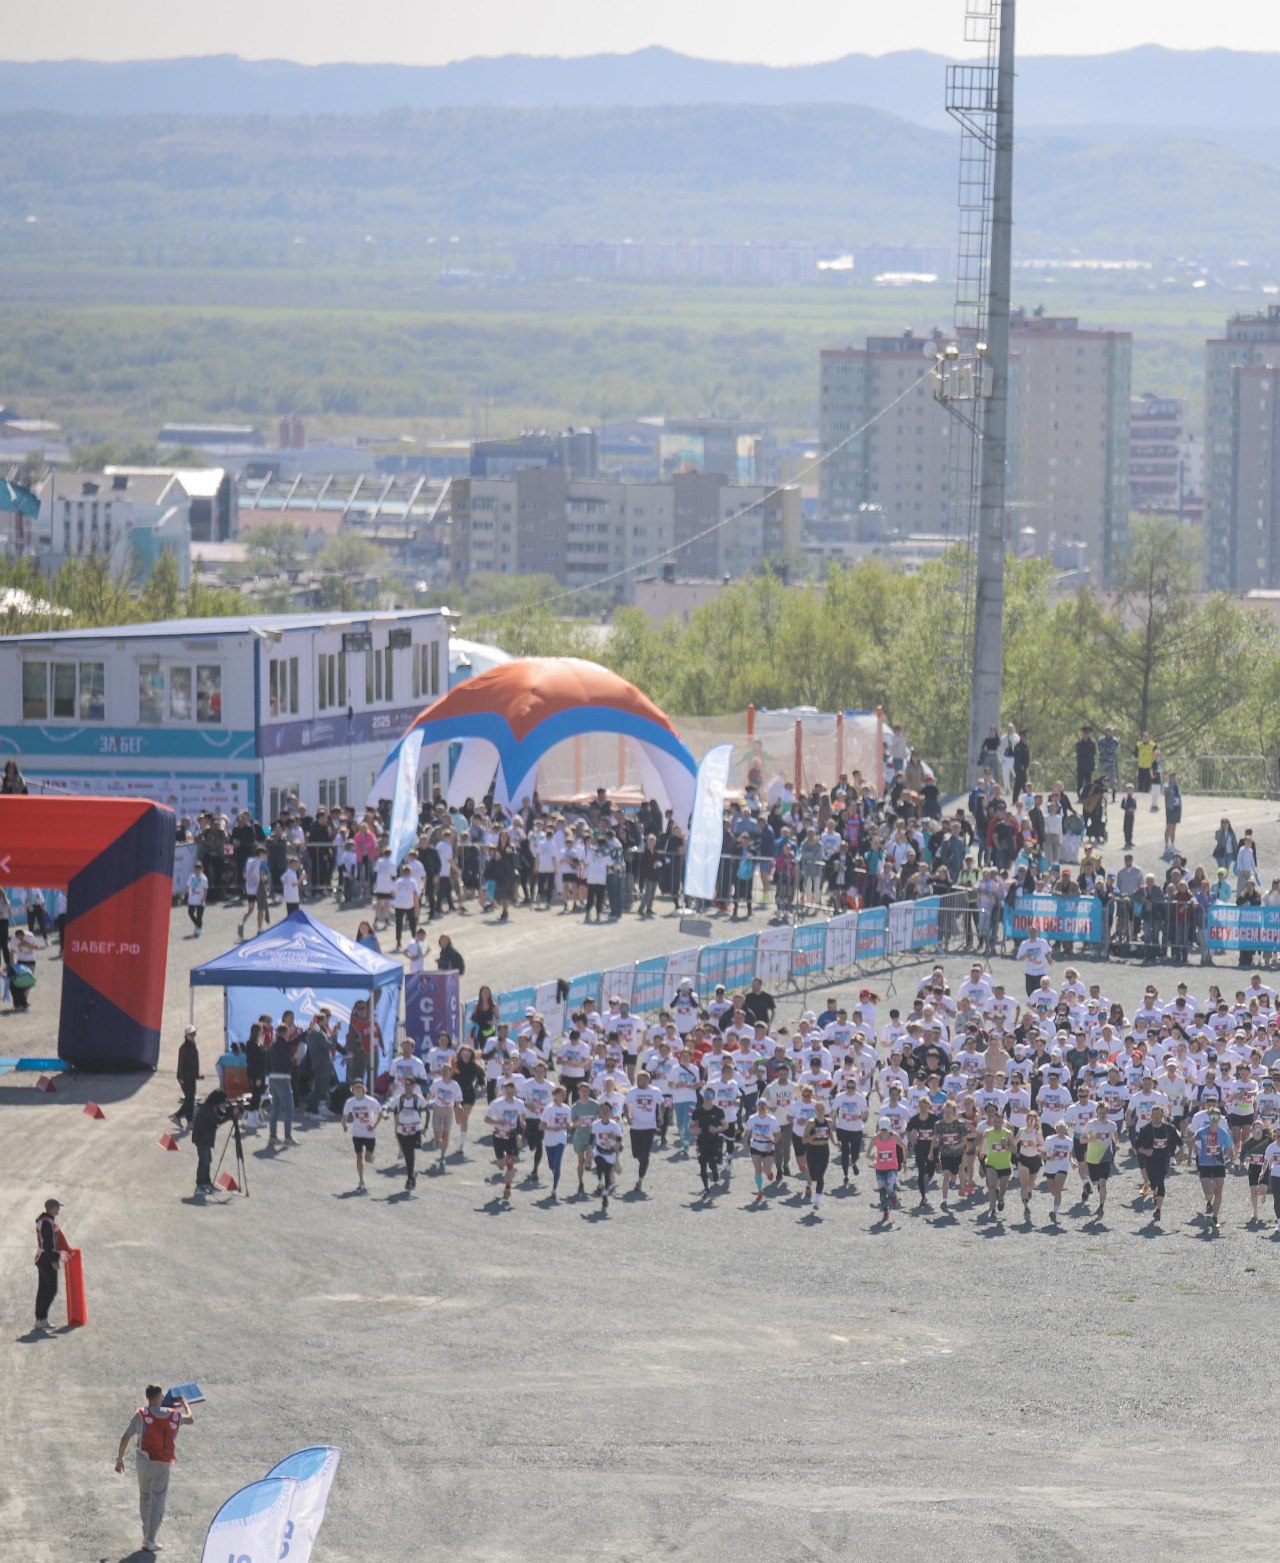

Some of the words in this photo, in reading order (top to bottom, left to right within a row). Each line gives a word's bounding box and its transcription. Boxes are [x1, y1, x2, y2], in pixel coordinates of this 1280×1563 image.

[1210, 926, 1232, 940] БЕГУ
[1234, 928, 1258, 942] ВСЕМ
[71, 940, 140, 955] ЗАБЕГ.РФ
